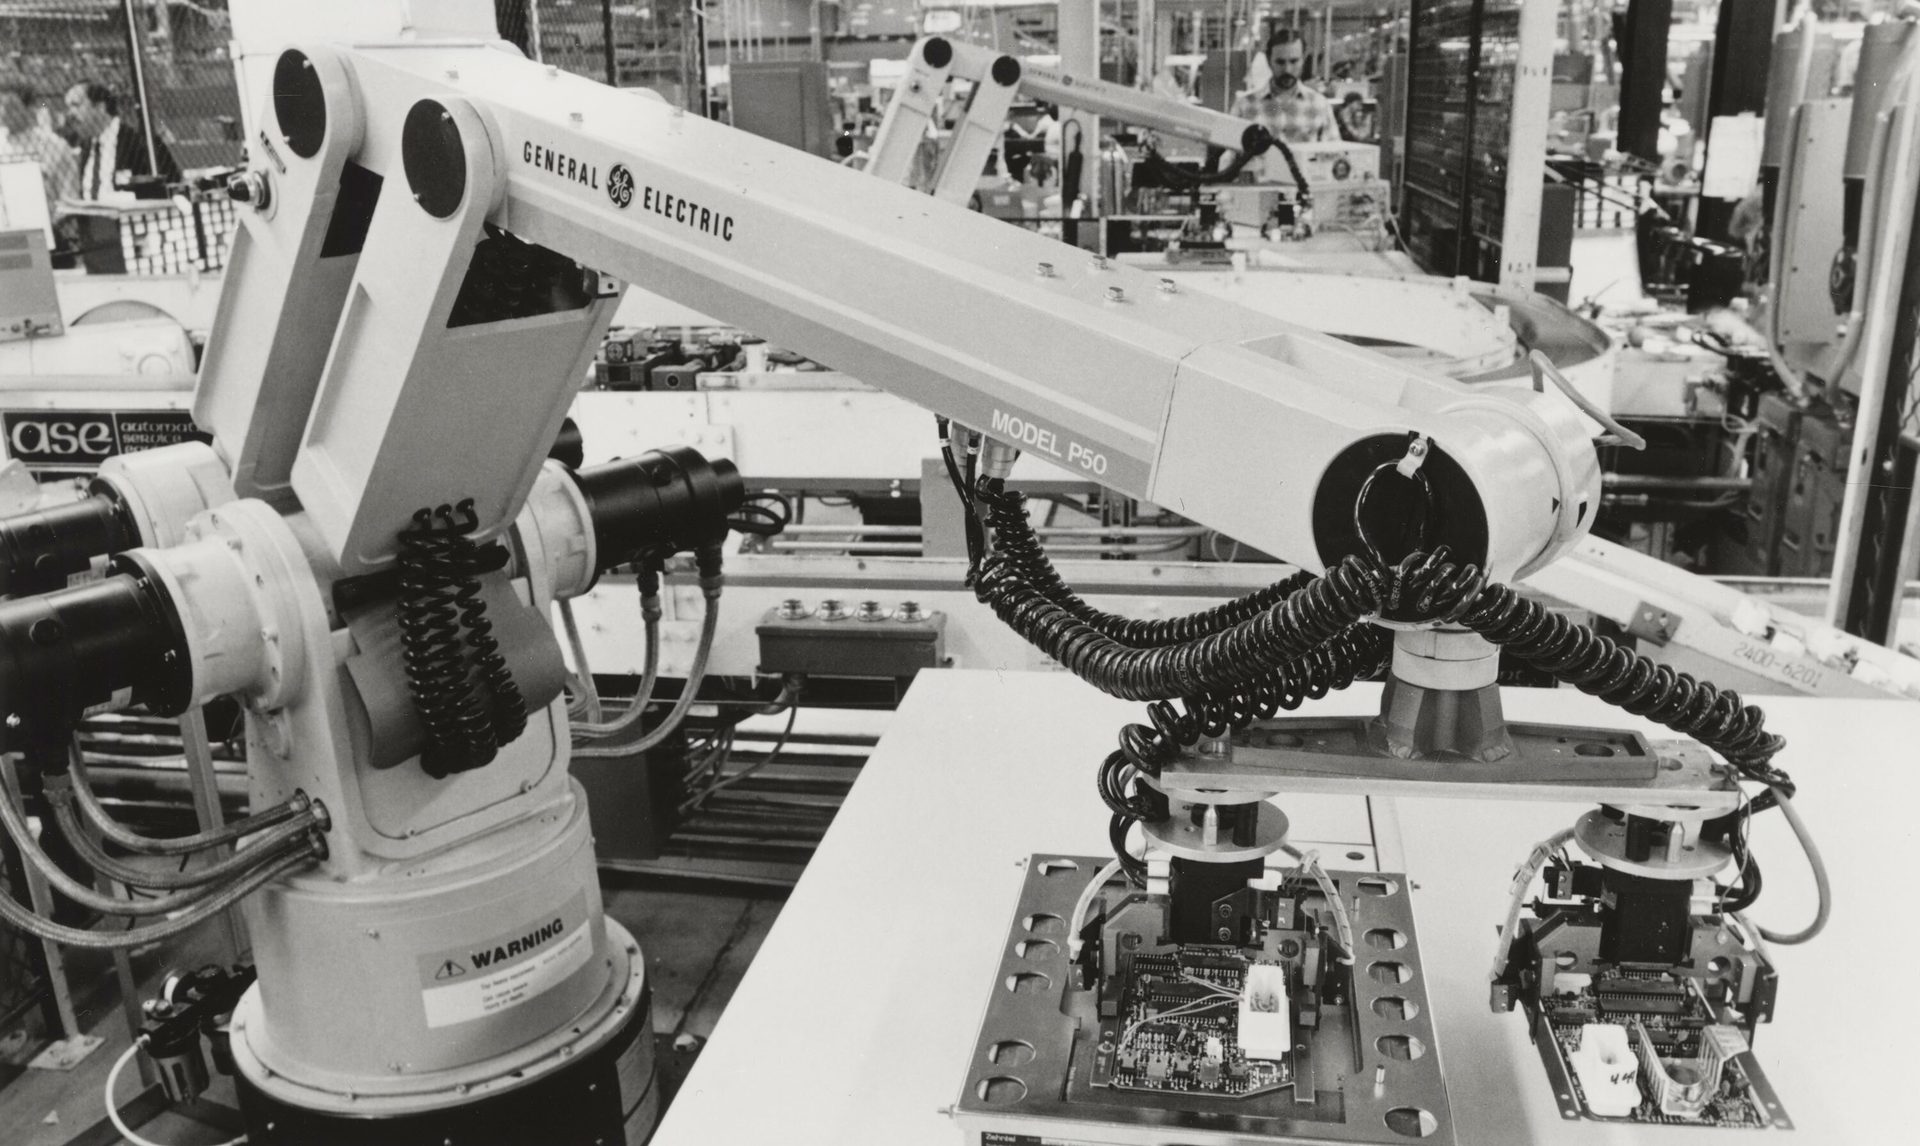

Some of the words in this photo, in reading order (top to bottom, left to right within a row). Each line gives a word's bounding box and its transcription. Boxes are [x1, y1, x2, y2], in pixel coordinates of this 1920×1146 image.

[523, 140, 599, 190] GENERAL
[643, 186, 734, 242] ELECTRIC
[12, 421, 113, 454] ase
[991, 408, 1062, 457] MODEL
[1068, 441, 1107, 475] P50
[1733, 641, 1823, 688] 2400-6201
[471, 918, 564, 969] WARNING
